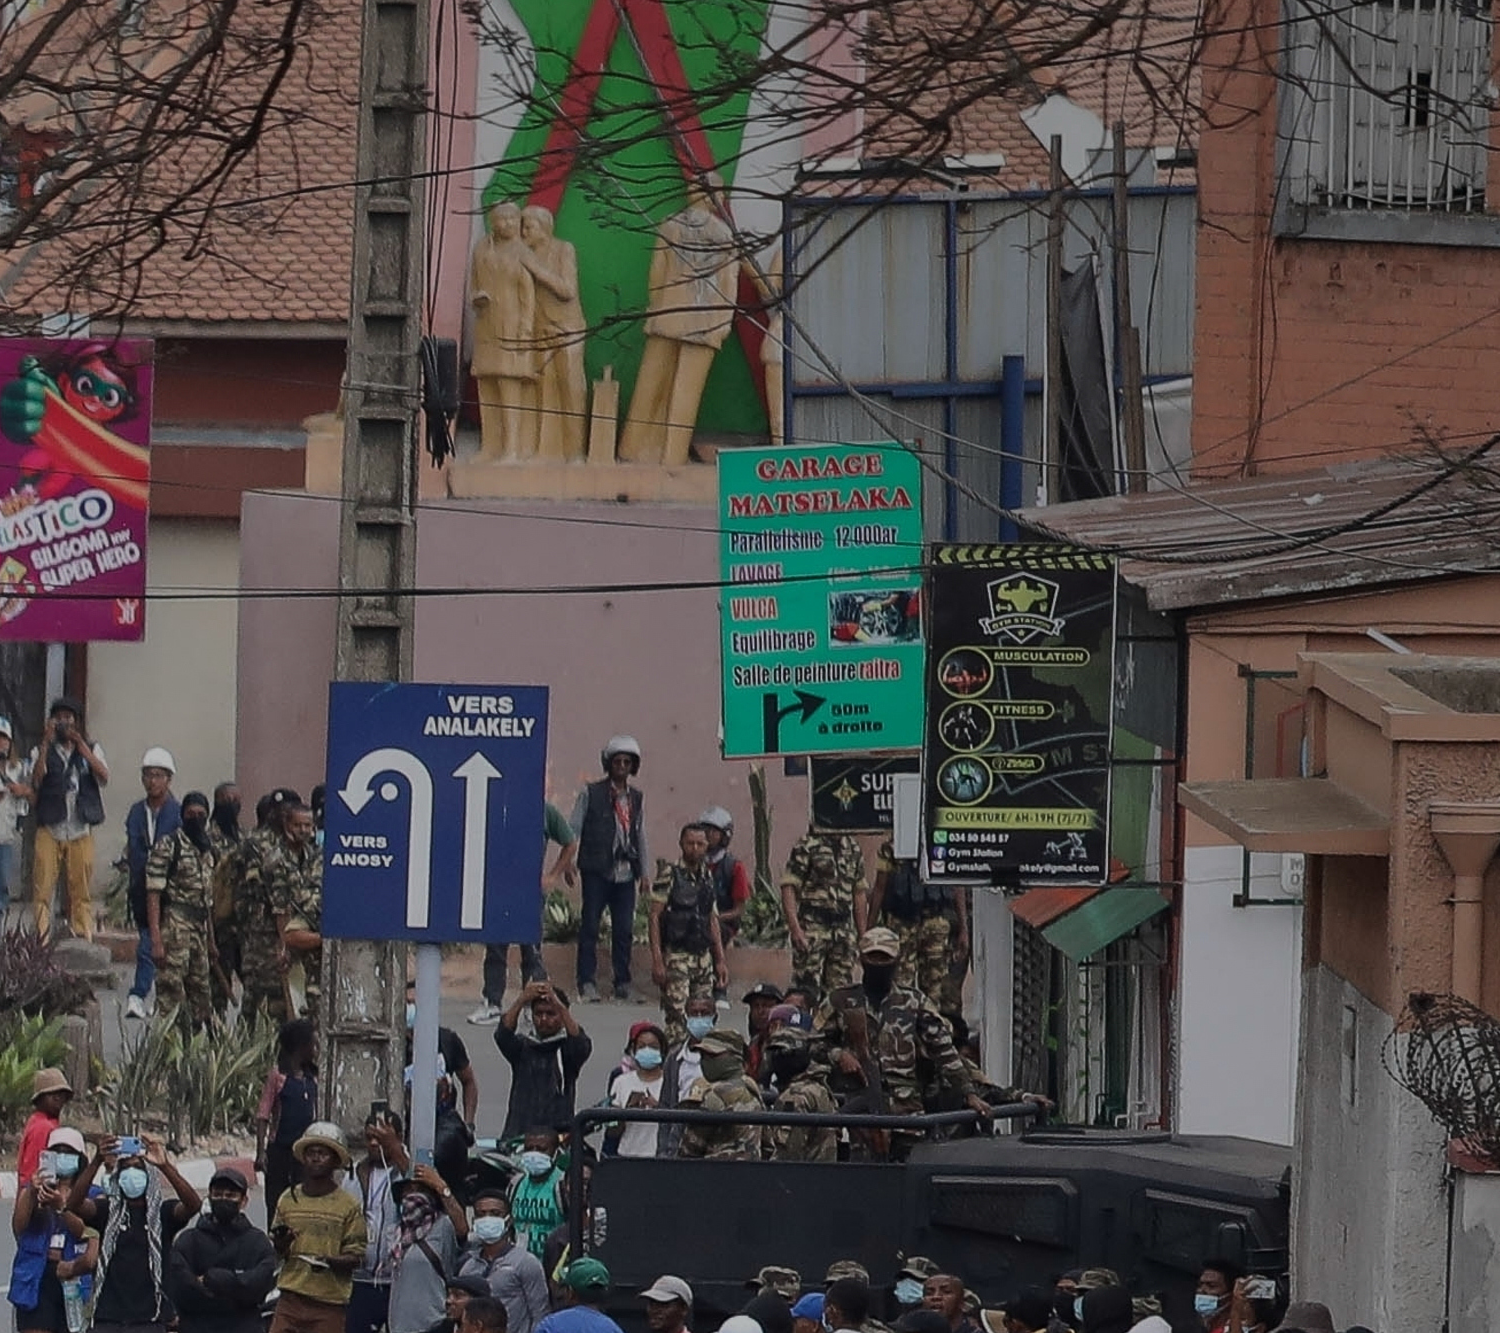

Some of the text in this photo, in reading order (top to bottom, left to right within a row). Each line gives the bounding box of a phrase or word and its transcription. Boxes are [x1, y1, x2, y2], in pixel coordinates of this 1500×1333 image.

[757, 454, 883, 482] GARAGE
[728, 487, 912, 518] MATSELAKA
[730, 596, 778, 620] VULCA
[732, 629, 815, 656] Equilibrage
[993, 652, 1084, 662] MUSCULATION
[733, 664, 770, 688] Salle
[773, 664, 791, 684] de
[794, 661, 856, 686] peinture
[448, 695, 514, 715] VERS
[992, 705, 1045, 715] FITNESS
[423, 717, 535, 738] ANALAKELY
[339, 835, 388, 849] VERS
[330, 853, 394, 868] ANOSY
